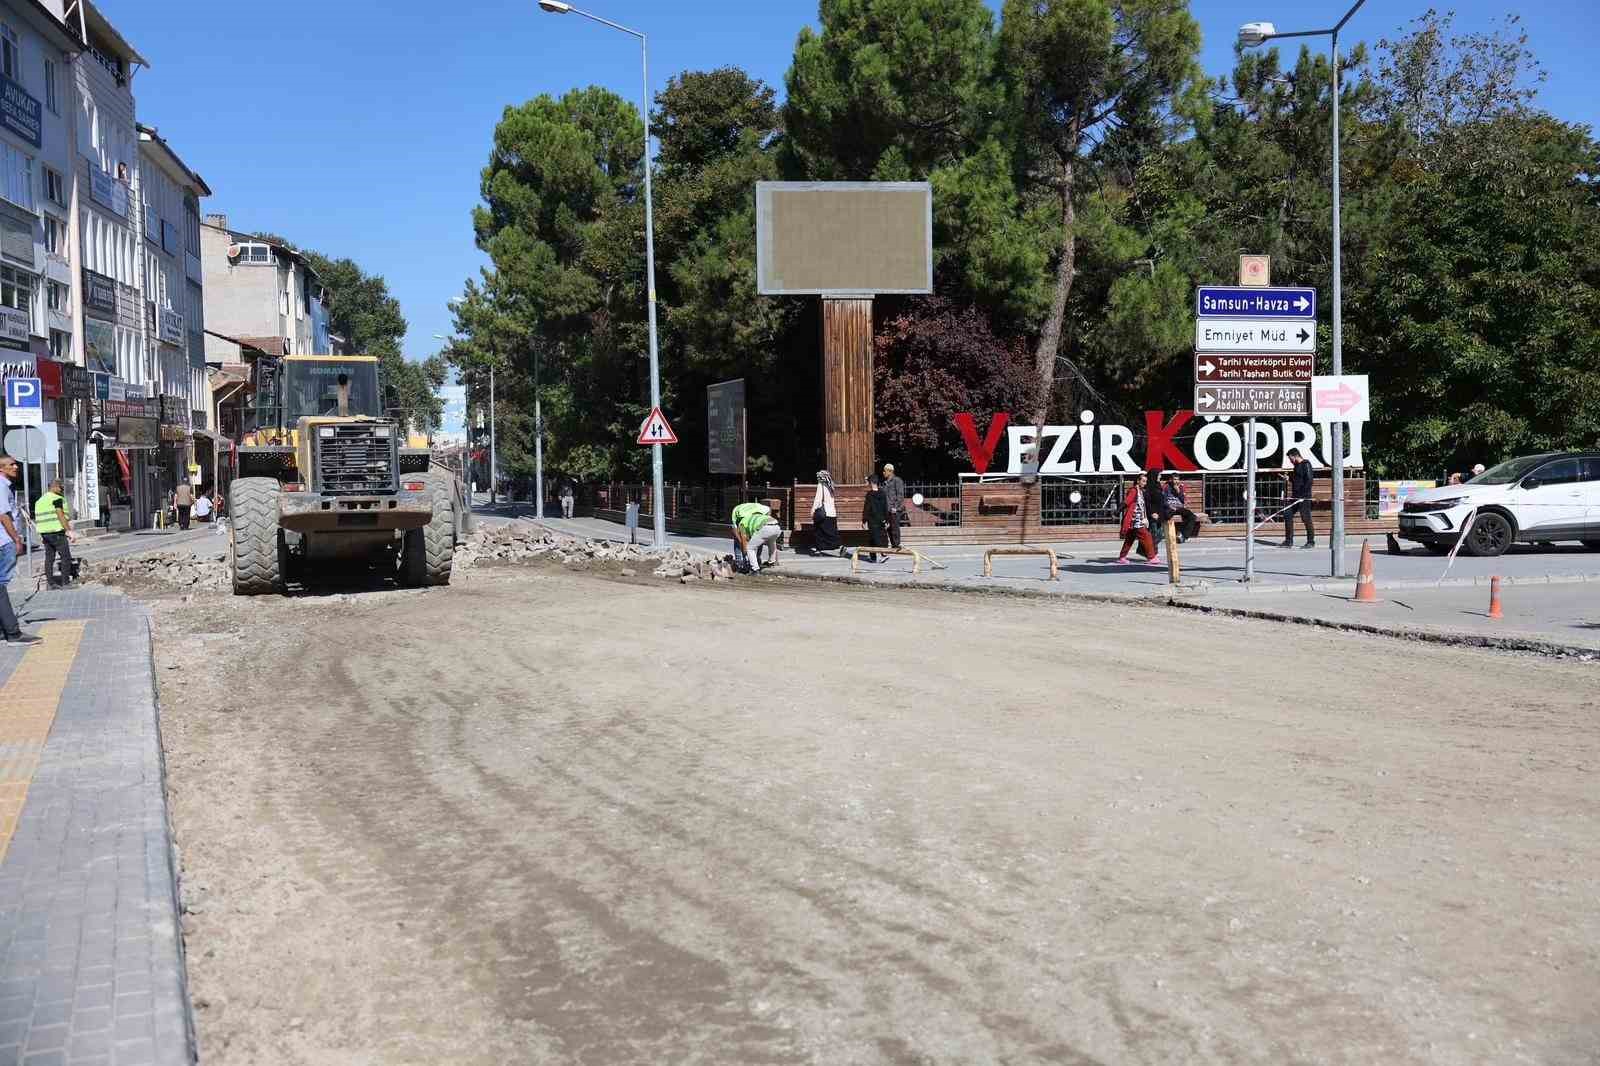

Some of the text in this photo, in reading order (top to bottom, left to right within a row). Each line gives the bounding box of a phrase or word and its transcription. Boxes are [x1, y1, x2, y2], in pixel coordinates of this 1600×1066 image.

[5, 83, 37, 114] AVUKAT
[1204, 296, 1289, 310] Samsun-Havza
[1205, 329, 1288, 343] Emniyet Müd.
[1219, 358, 1312, 367] Tarihi Vezirköprü Evleri
[1219, 369, 1312, 378] Tarihi Taşhan Butik Otel
[14, 382, 34, 405] P
[1216, 388, 1304, 401] Tarihi Çınar Ağacı
[1216, 401, 1304, 411] Abdullah Derici Konağı
